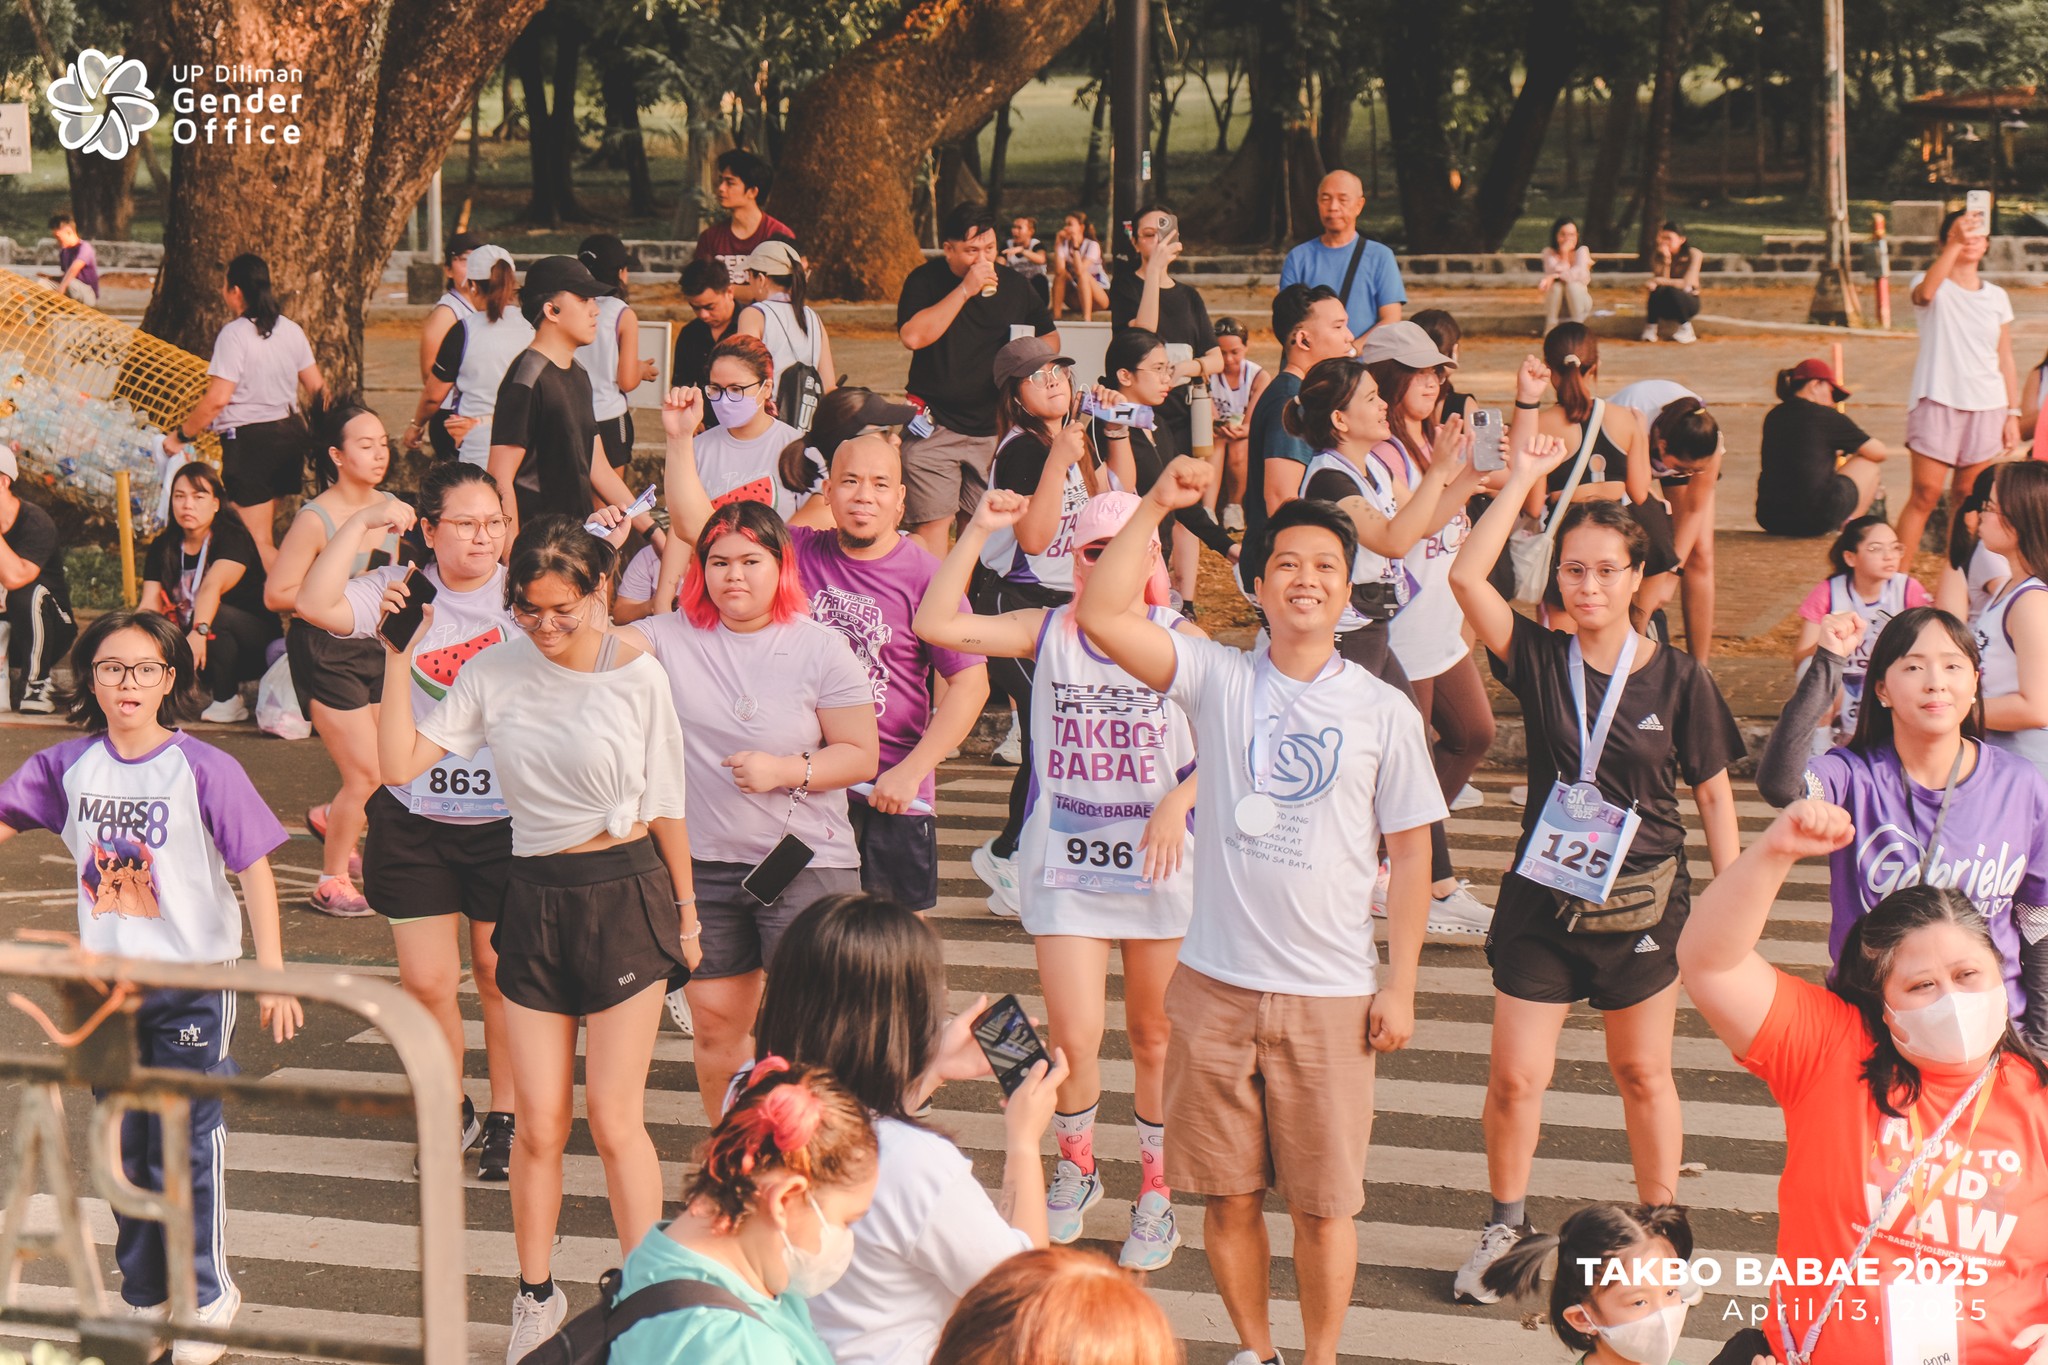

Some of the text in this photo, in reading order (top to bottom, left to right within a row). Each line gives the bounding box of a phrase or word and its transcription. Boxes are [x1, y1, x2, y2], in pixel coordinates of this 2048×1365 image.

[1052, 715, 1158, 750] TAKBO
[1047, 749, 1156, 784] BABAE
[429, 767, 491, 795] 863
[1055, 795, 1152, 818] TAKBO BABAE
[1567, 788, 1589, 805] 5K
[1290, 815, 1309, 825] ANG
[1573, 809, 1593, 820] 2025
[1067, 838, 1133, 869] 936
[1290, 838, 1303, 846] AT
[1272, 856, 1285, 865] SA
[1288, 859, 1313, 871] BATA
[1541, 833, 1613, 879] 125
[1867, 841, 2027, 901] Gabriela
[618, 972, 636, 986] RUN
[1979, 1149, 2021, 1173] TO
[1866, 1183, 2019, 1255] VAW
[1851, 1222, 1916, 1249] GENER-BASED
